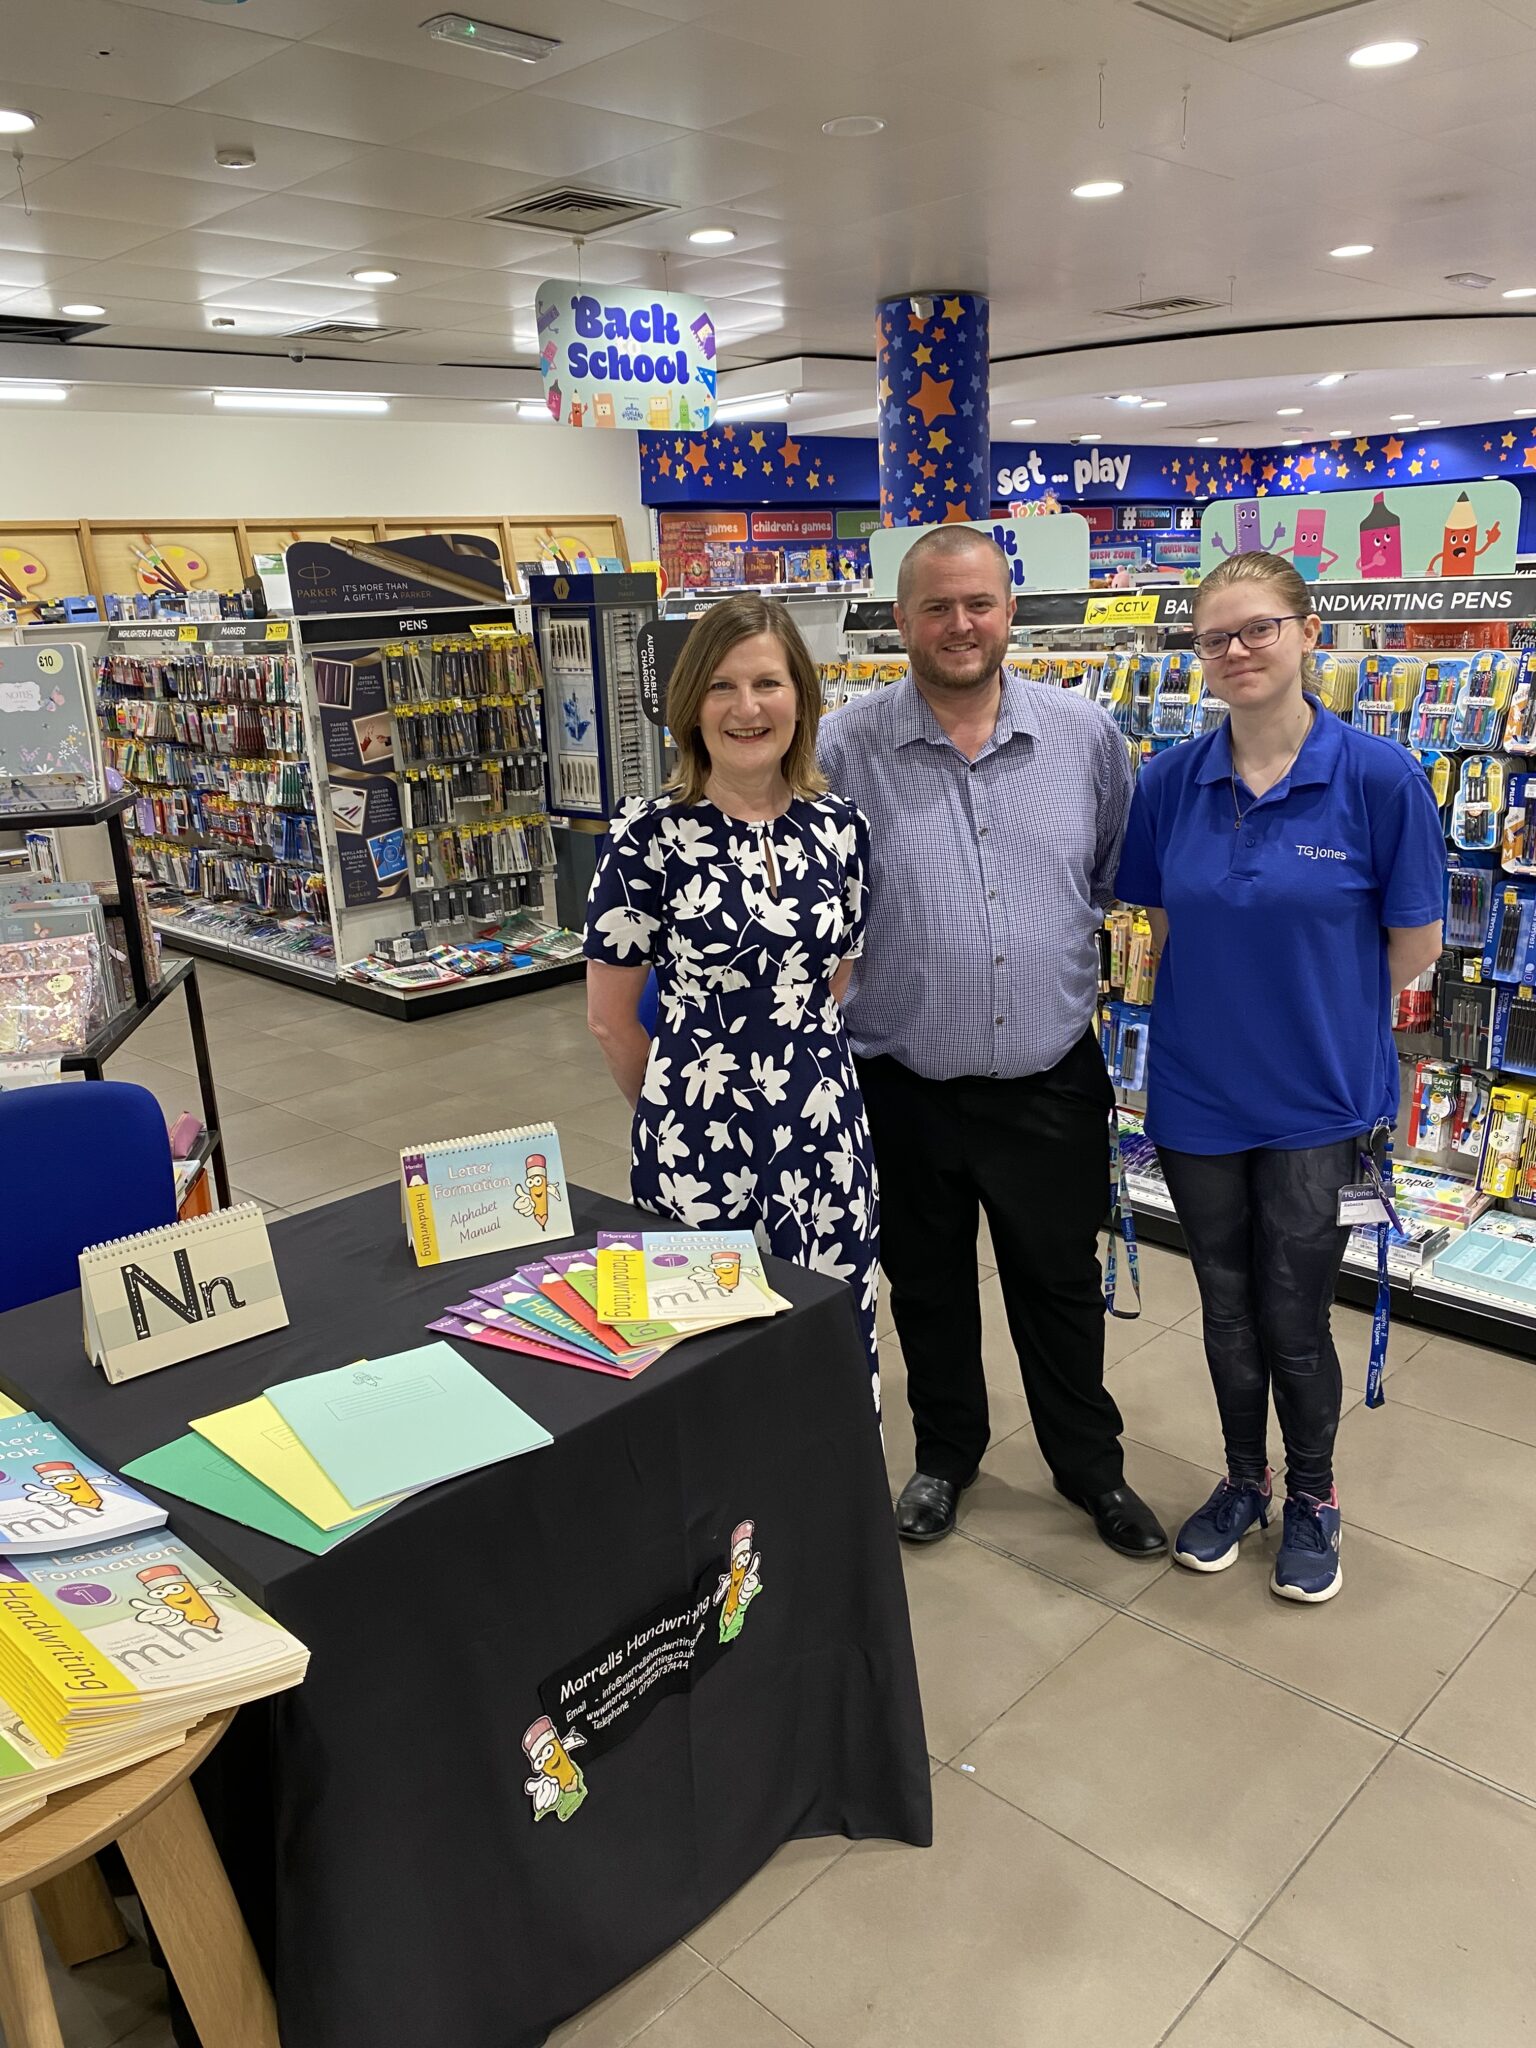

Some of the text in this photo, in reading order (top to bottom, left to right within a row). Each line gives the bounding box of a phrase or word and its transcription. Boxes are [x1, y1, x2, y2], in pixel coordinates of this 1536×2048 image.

[571, 295, 680, 345] Back
[567, 342, 690, 385] School
[997, 450, 1046, 495] set
[1073, 448, 1131, 494] play
[1139, 510, 1170, 518] TRENDING
[753, 519, 831, 535] children's games
[1113, 551, 1136, 559] ZONE
[1160, 545, 1199, 554] SQUISH ZONE
[297, 588, 337, 598] PARKER
[342, 582, 408, 592] IT'S MORE THAN
[344, 594, 350, 602] A
[352, 593, 374, 602] GIFT,
[375, 592, 390, 600] IT'S
[401, 591, 432, 599] PARKER
[1450, 591, 1513, 609] PENS
[1115, 601, 1149, 612] CCTV
[118, 630, 147, 638] HIGHLIGHTERS
[151, 629, 176, 637] FINELINERS
[221, 627, 246, 635] MARKERS
[399, 619, 428, 631] PENS
[647, 634, 655, 666] AUDIO,
[1413, 639, 1434, 647] EASY
[1438, 639, 1450, 647] AS
[38, 655, 54, 667] £10
[640, 649, 651, 698] CHARGING
[1519, 663, 1527, 682] PILOT
[649, 668, 658, 705] CABLES
[1295, 844, 1347, 860] TGJones
[1488, 915, 1496, 939] ERASABLE
[1433, 1078, 1453, 1087] EASY
[448, 1161, 493, 1179] Letter
[433, 1176, 512, 1199] Formation
[1344, 1190, 1374, 1199] TGJones
[449, 1201, 498, 1228] Alphabet
[415, 1193, 432, 1257] Handwriting
[459, 1216, 502, 1244] Manual
[649, 1243, 751, 1251] Formation
[669, 1235, 728, 1243] Letter
[665, 1257, 675, 1267] 1
[120, 1248, 246, 1341] Nn
[604, 1253, 636, 1318] Handwriting
[51, 1541, 135, 1567] Letter
[31, 1545, 182, 1582] Formation
[73, 1589, 98, 1604] 1
[0, 1588, 108, 1690] Handwriting
[560, 1596, 710, 1704] Morrells Handwriting
[566, 1700, 587, 1722] Email
[592, 1701, 630, 1730] Telephone
